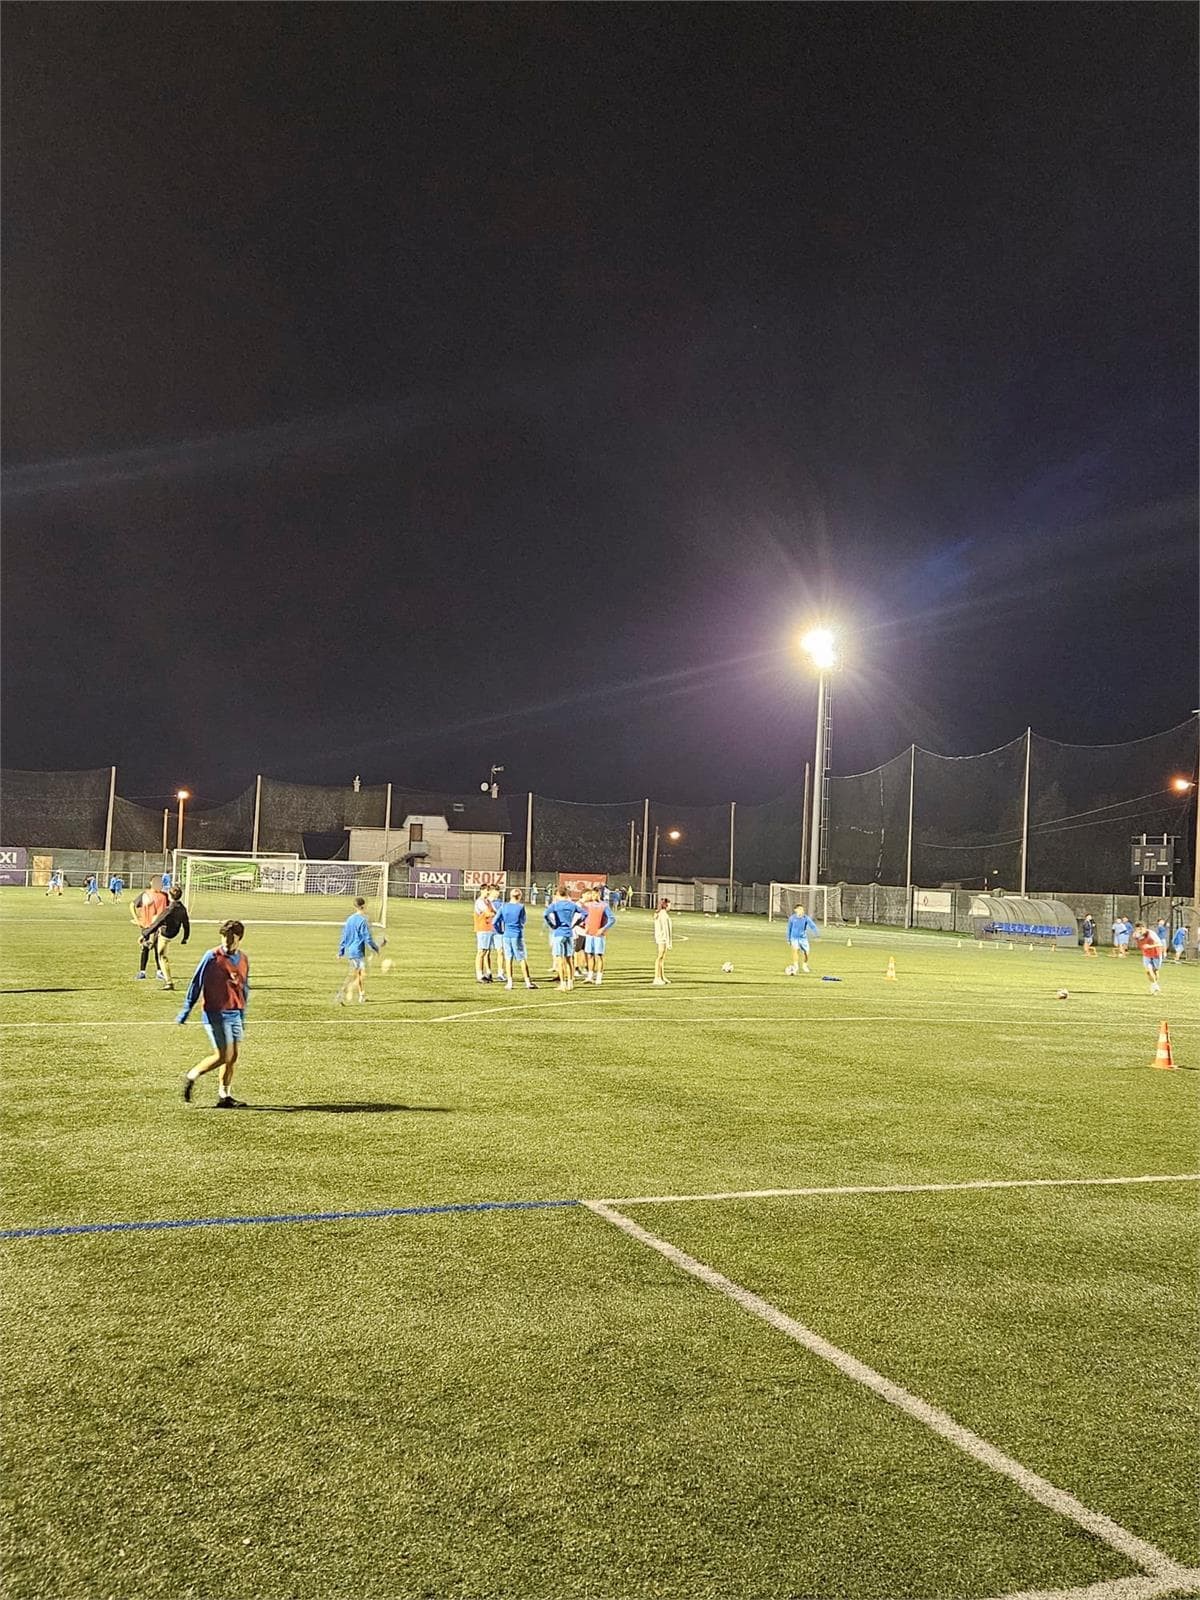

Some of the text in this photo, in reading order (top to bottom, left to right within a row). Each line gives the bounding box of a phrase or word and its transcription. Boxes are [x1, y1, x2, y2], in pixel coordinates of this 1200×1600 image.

[0, 851, 17, 864] XI
[419, 871, 451, 884] BAXI
[465, 871, 504, 885] FROIZ
